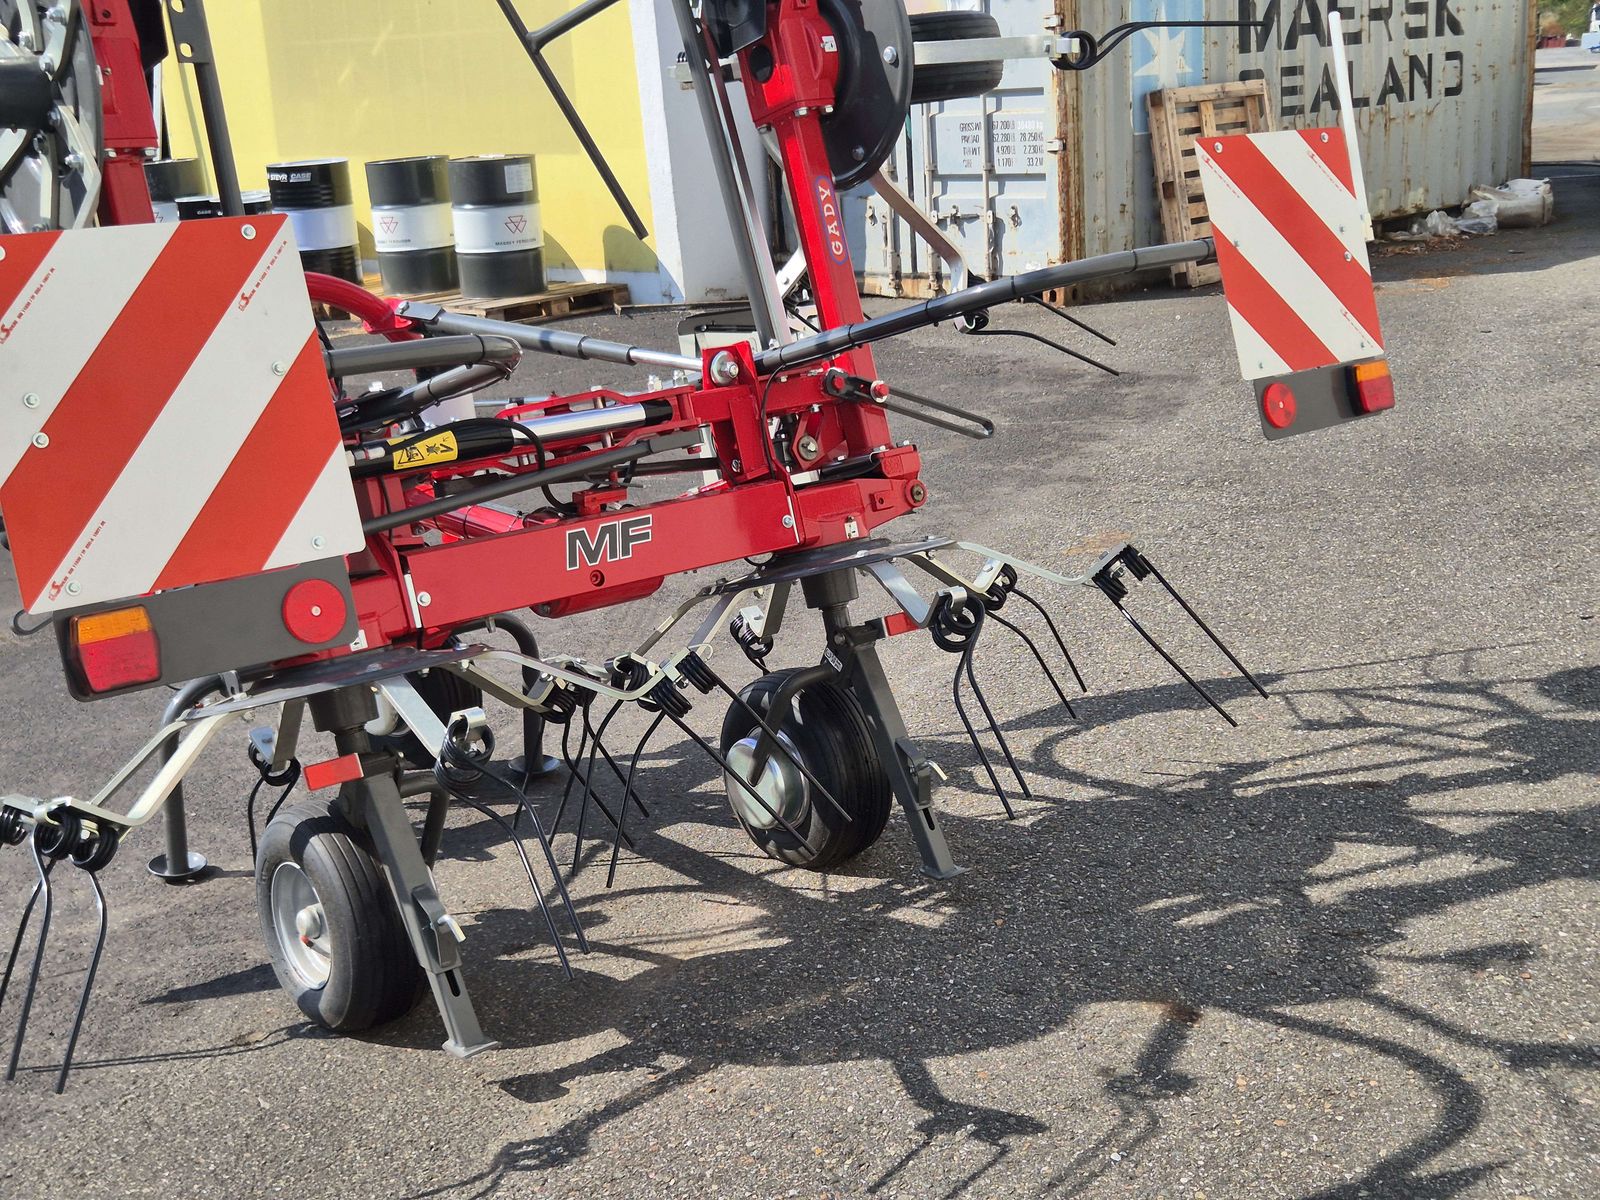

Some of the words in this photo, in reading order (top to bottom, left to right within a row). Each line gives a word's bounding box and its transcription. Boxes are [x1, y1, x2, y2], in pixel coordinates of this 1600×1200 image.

[1238, 0, 1464, 54] MAERSK
[290, 172, 312, 183] CASE
[818, 185, 844, 256] GADY
[566, 514, 652, 571] MF
